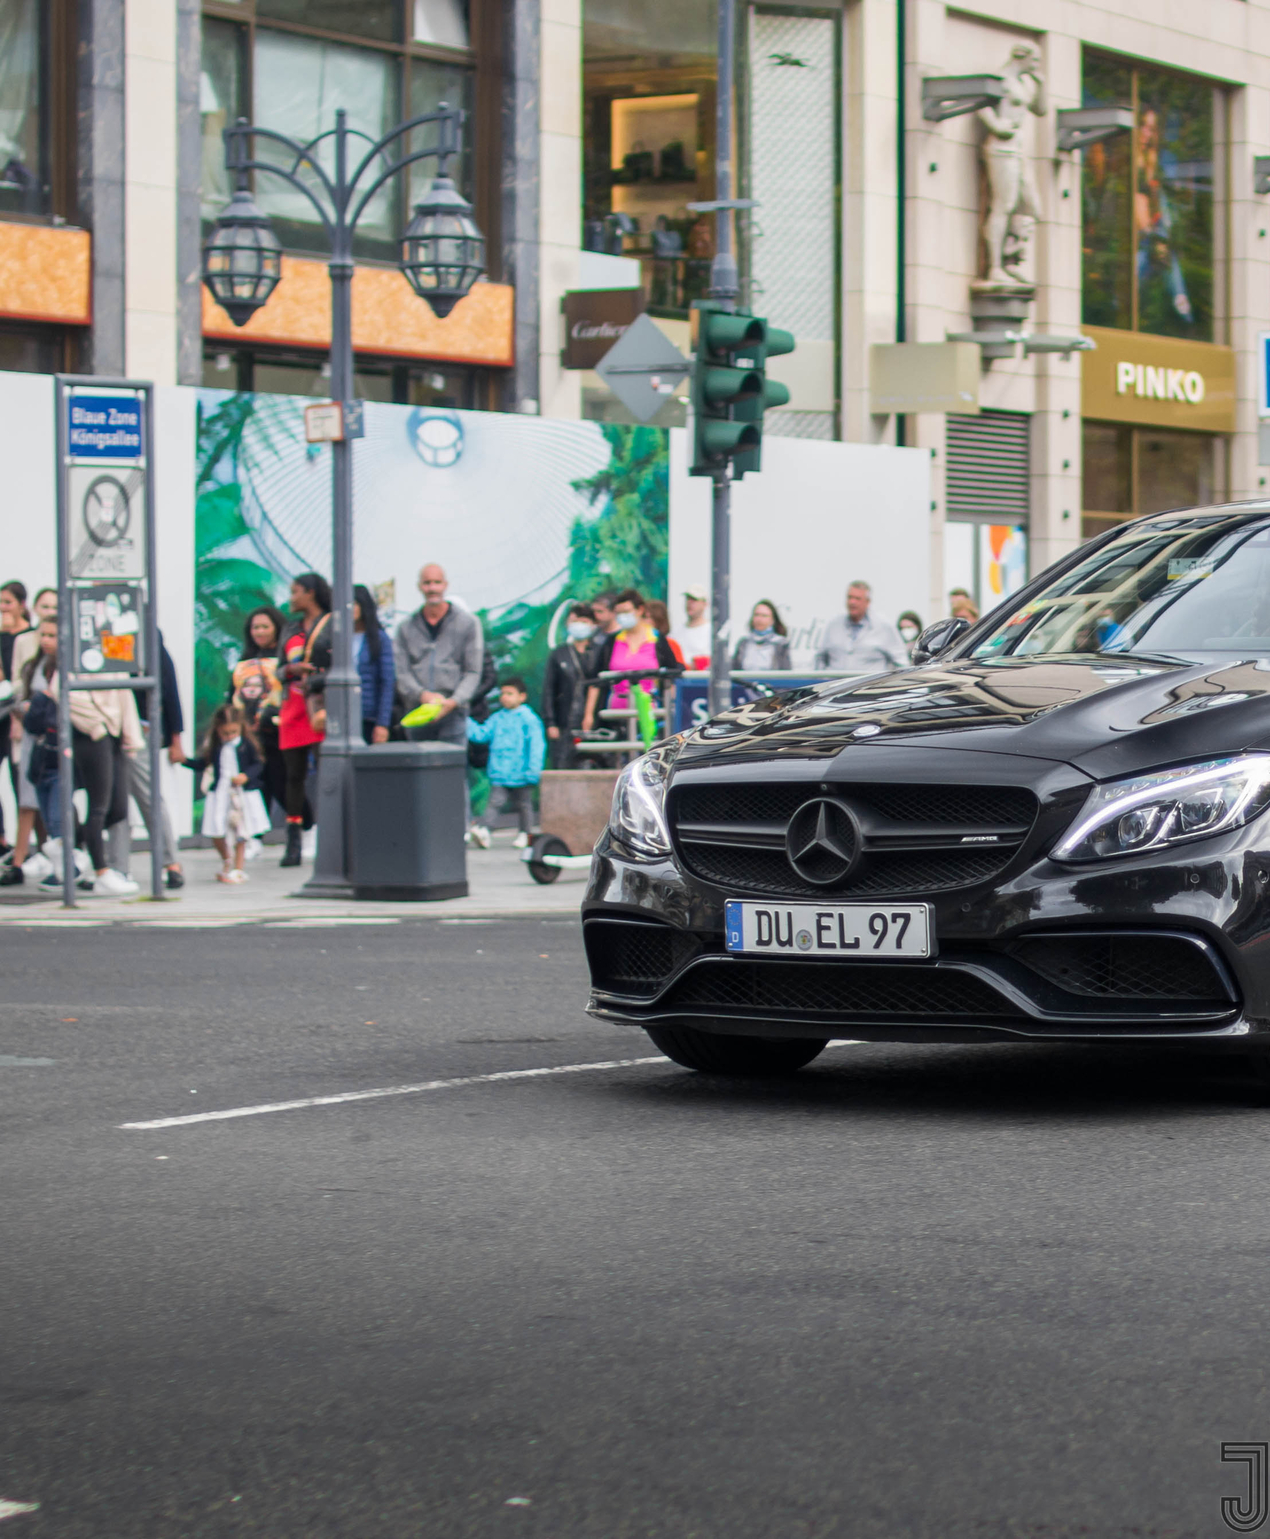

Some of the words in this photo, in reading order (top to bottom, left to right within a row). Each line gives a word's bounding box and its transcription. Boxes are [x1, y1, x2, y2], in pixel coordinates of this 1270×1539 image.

[1117, 361, 1205, 404] PINKO
[72, 406, 106, 425] Blaue
[107, 408, 137, 426] Zone
[70, 429, 139, 449] Königsallee
[732, 932, 739, 942] D
[755, 910, 793, 947] DU
[816, 912, 860, 949] EL
[869, 912, 911, 949] 97
